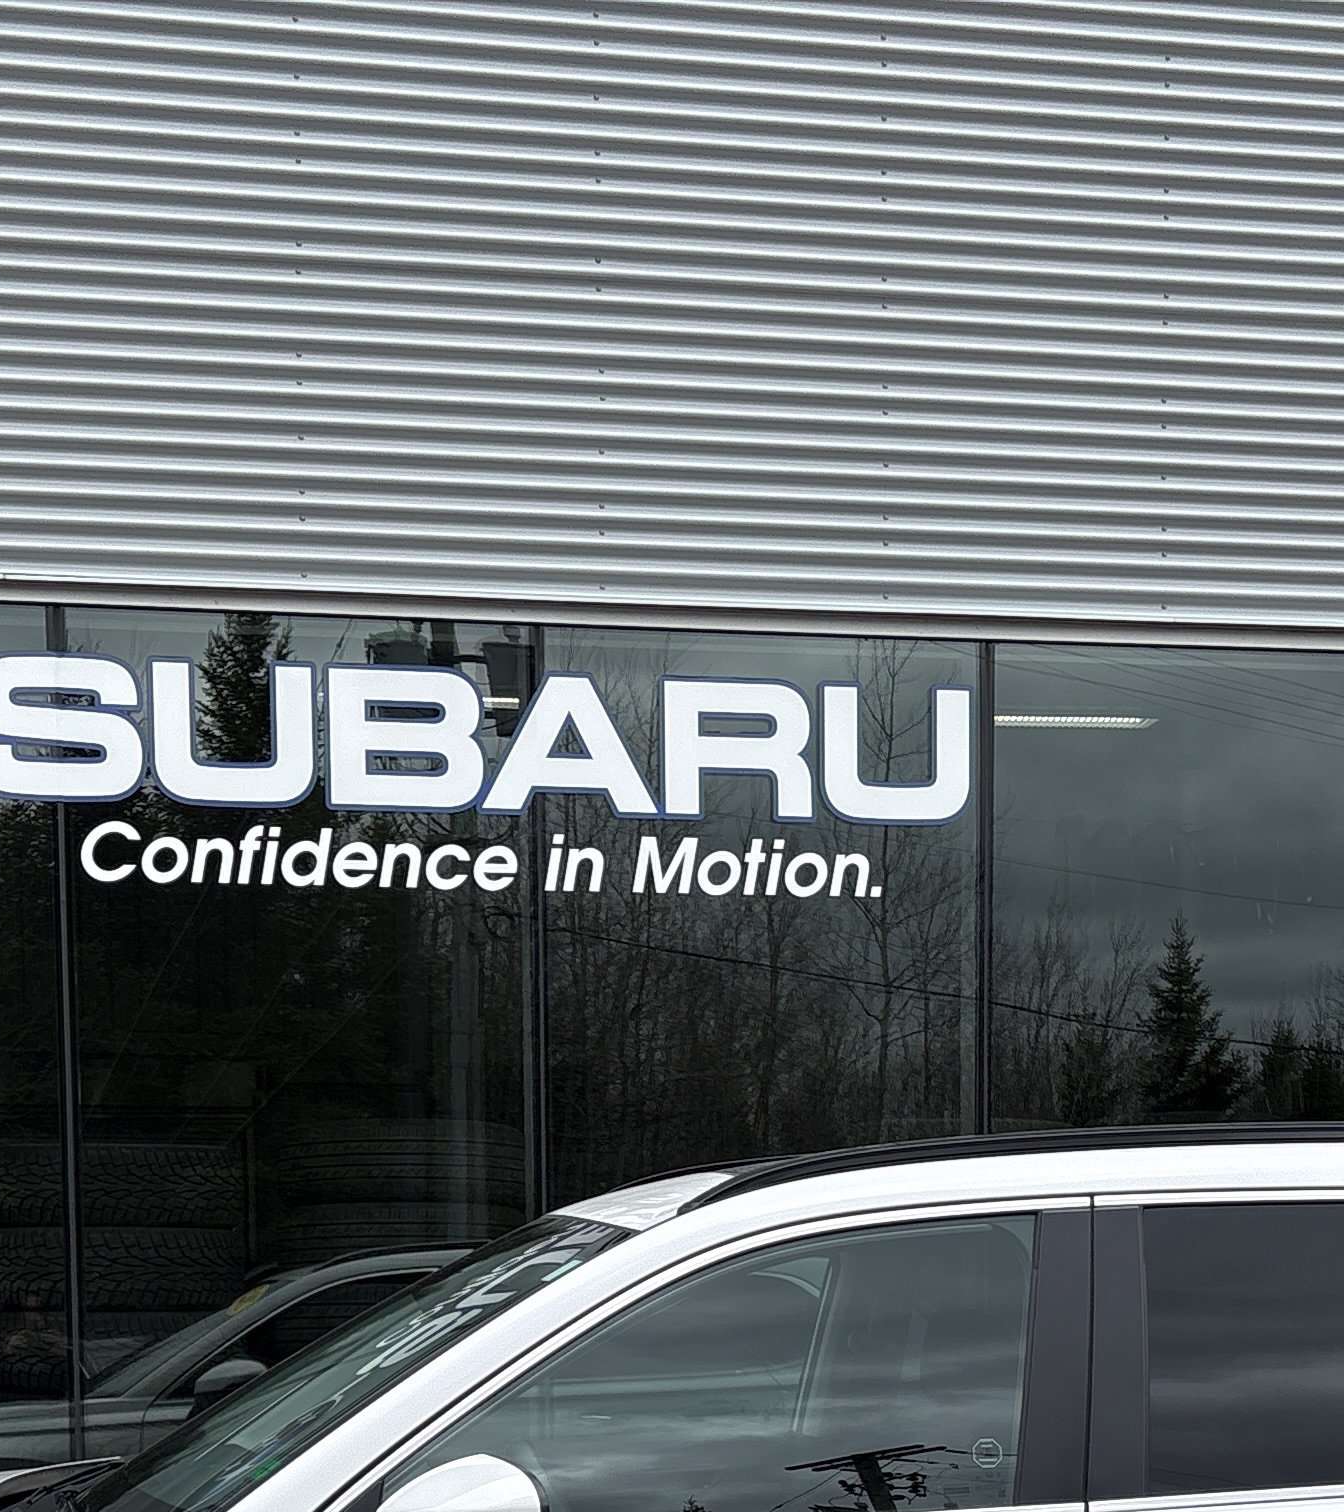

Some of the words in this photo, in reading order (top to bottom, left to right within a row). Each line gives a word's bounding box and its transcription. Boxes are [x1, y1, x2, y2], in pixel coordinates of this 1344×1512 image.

[80, 820, 518, 892] Confidence
[545, 833, 604, 892] in
[632, 836, 882, 898] Motion.
